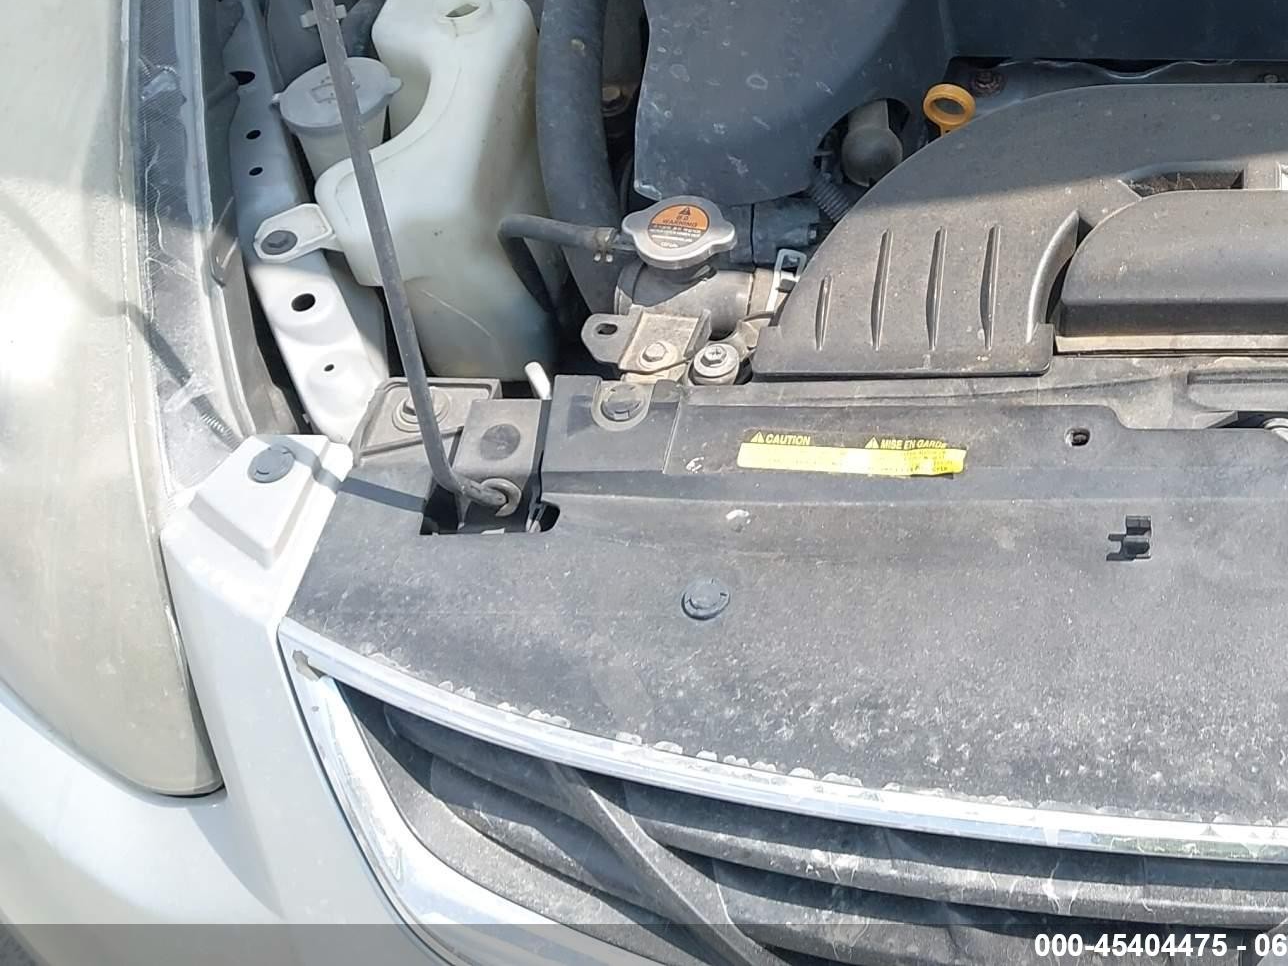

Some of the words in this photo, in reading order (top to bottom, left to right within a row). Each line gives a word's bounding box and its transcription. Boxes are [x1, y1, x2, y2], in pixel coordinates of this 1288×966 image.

[765, 434, 811, 446] CAUTION
[880, 439, 903, 450] MISE
[904, 439, 916, 449] EN
